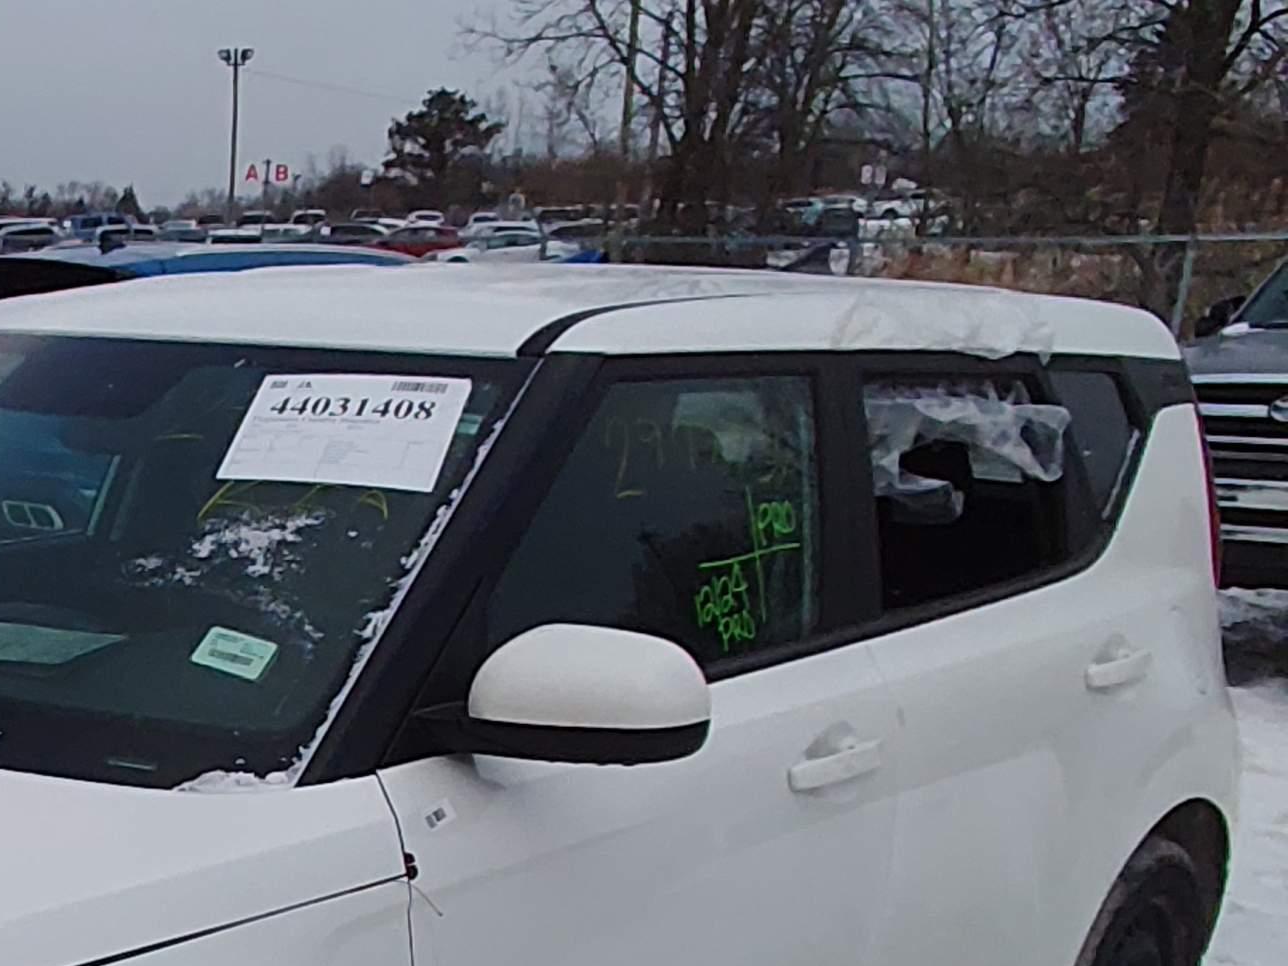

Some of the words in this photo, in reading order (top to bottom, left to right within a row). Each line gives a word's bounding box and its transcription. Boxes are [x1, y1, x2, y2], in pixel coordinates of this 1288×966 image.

[245, 163, 258, 181] A
[275, 164, 288, 181] B
[269, 396, 437, 421] 44031408
